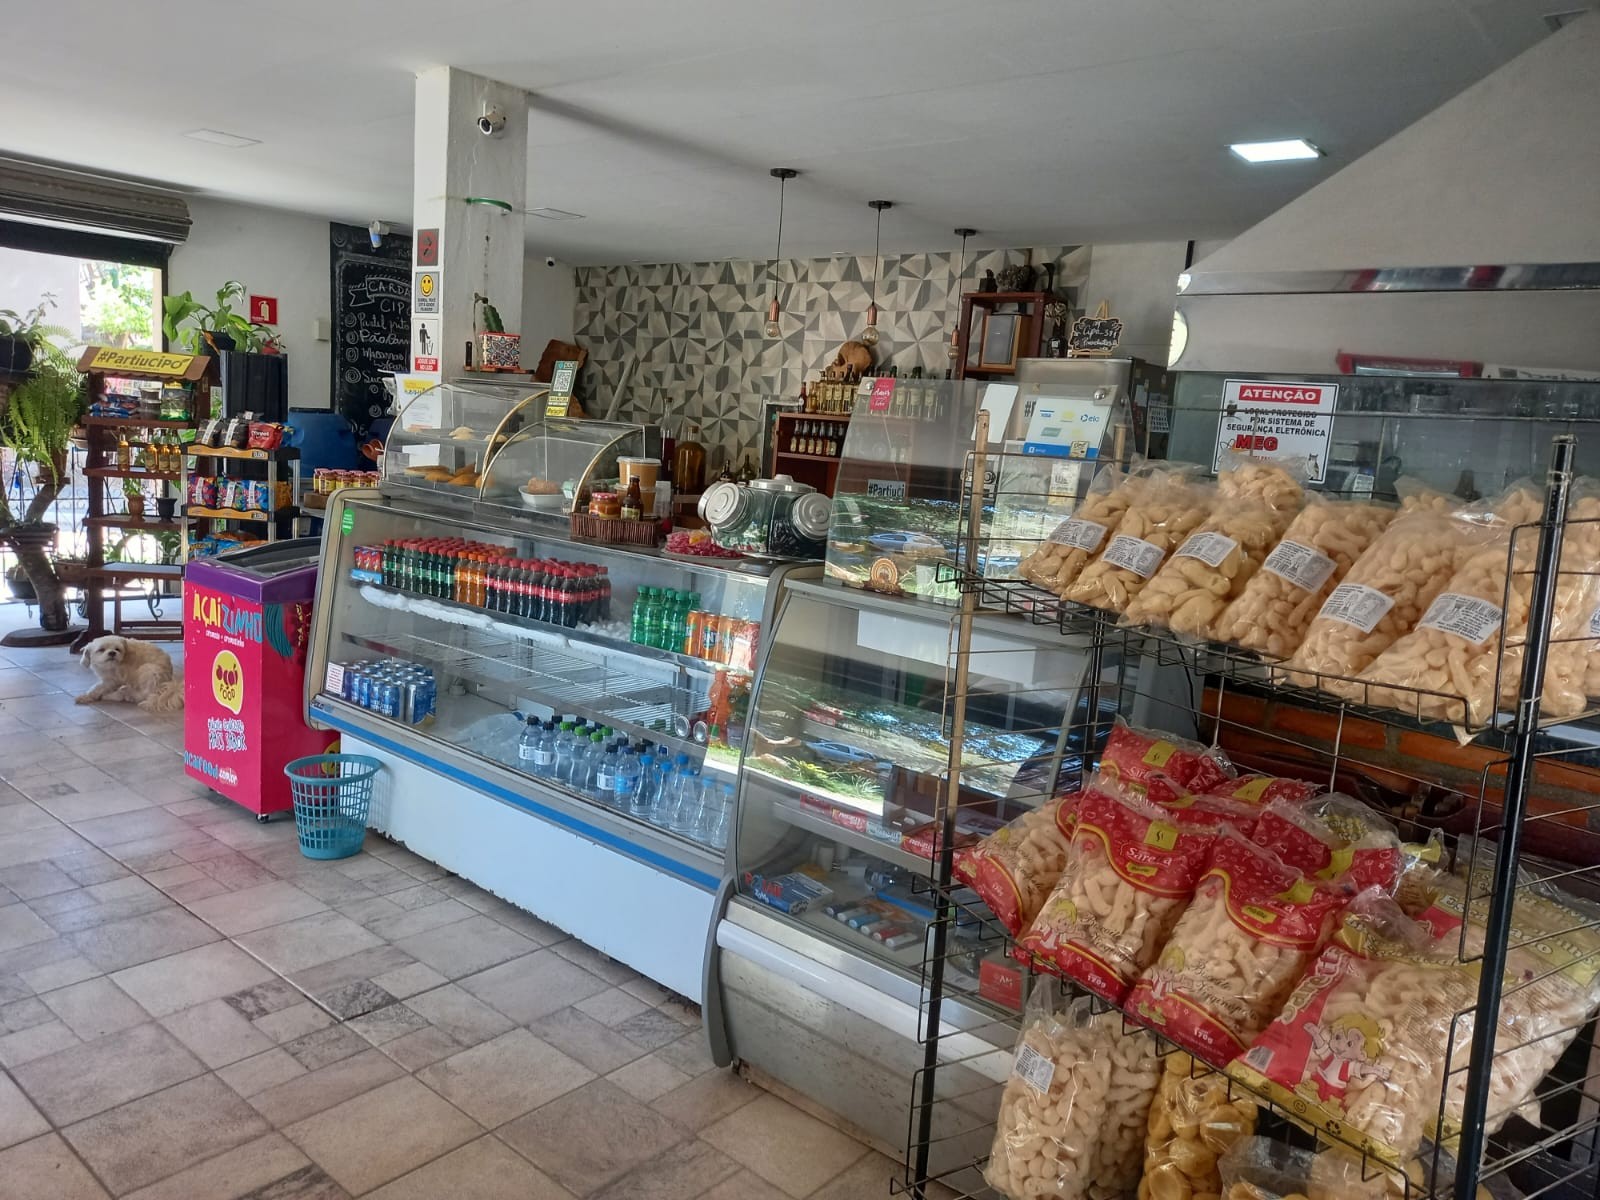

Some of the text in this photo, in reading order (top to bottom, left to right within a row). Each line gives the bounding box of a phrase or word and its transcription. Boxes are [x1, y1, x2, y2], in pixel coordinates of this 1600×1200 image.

[1242, 388, 1317, 402] ATENÇÃO
[1268, 418, 1302, 427] SISTEMA
[1304, 419, 1315, 427] DE
[1226, 423, 1326, 437] SEGURANÇA ELETRÔNICA
